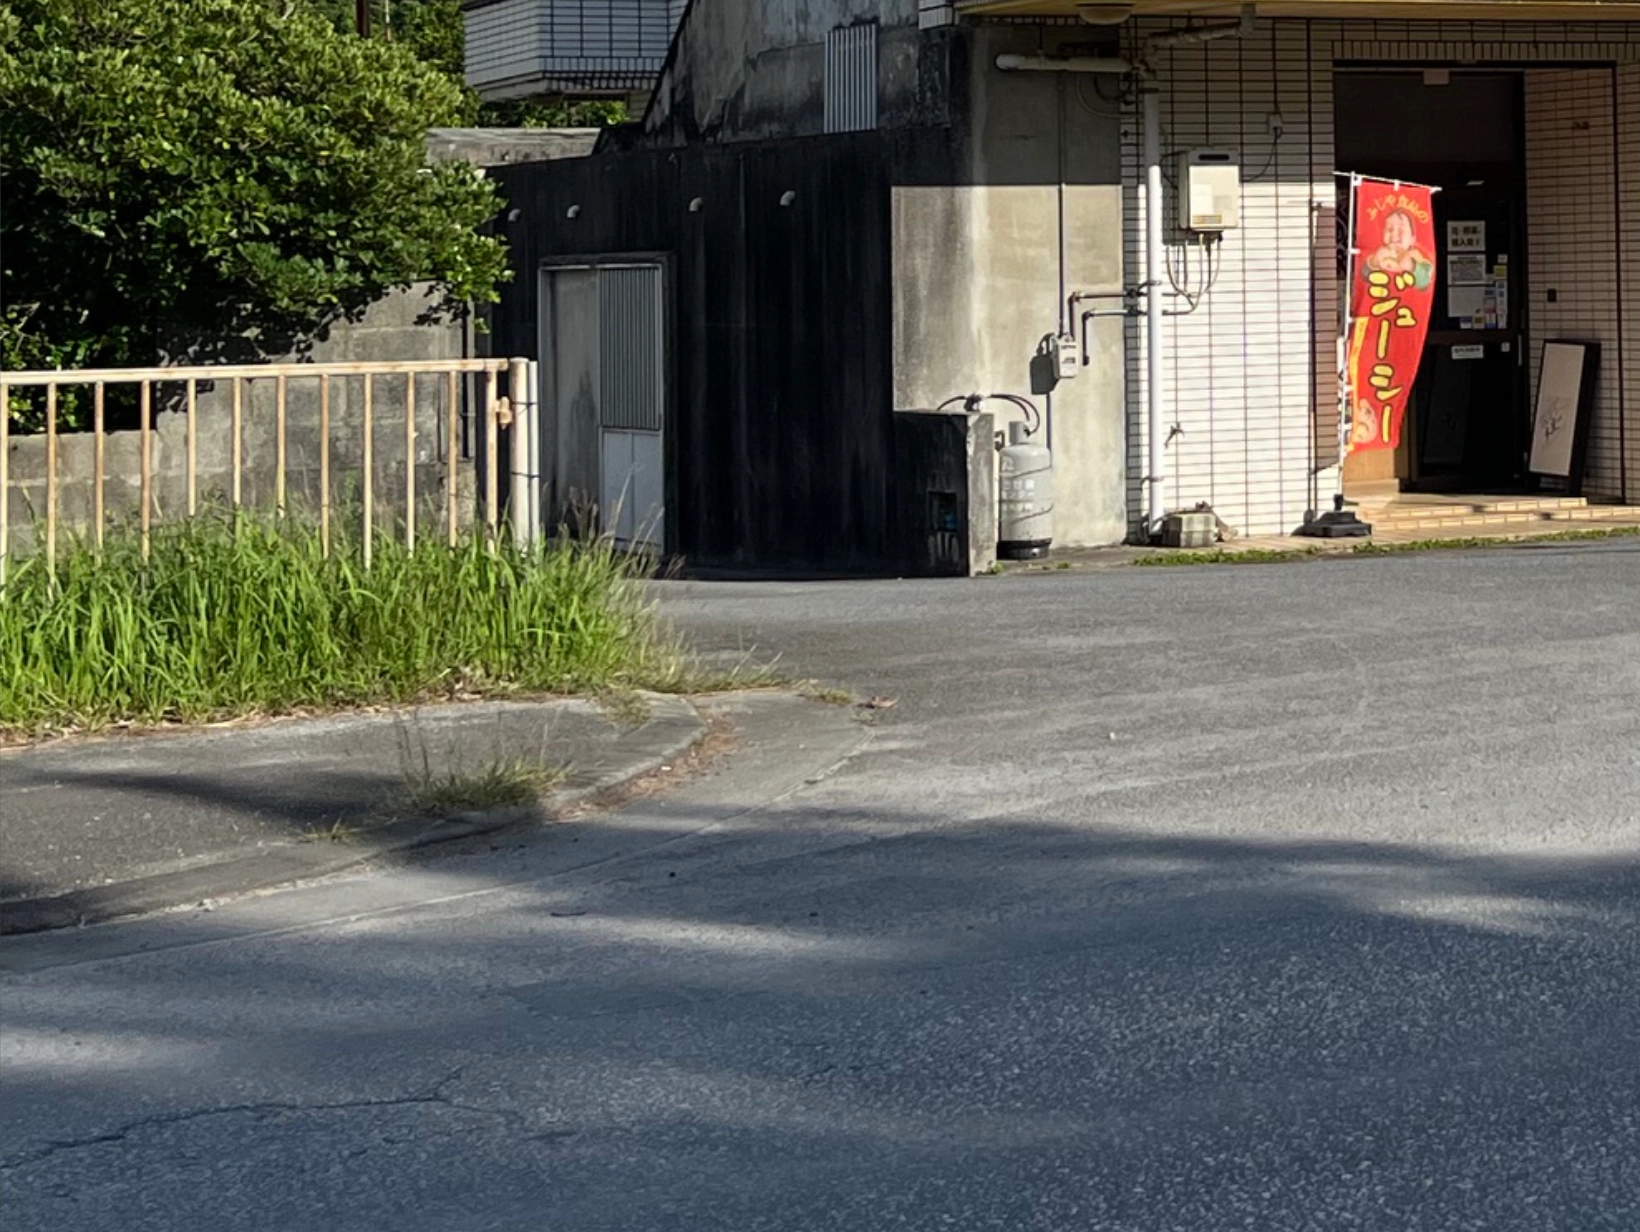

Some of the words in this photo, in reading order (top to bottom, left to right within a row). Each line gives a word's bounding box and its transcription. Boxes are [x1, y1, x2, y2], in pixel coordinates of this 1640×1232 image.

[1368, 271, 1419, 444] ジューシー
